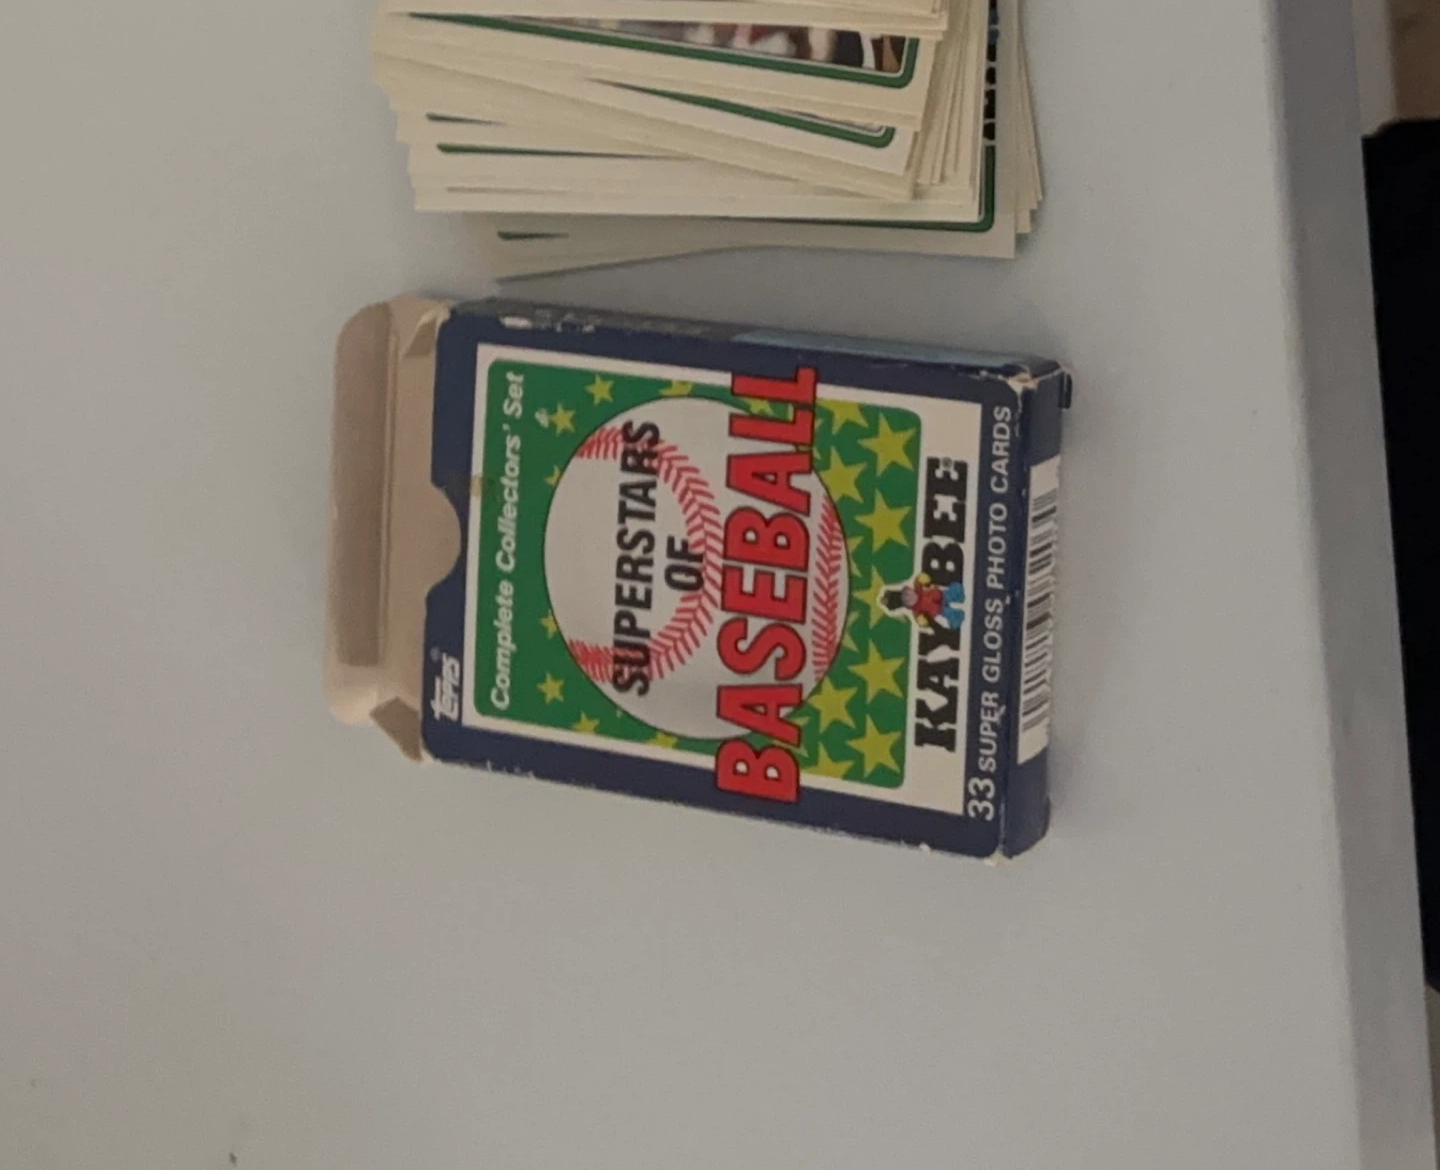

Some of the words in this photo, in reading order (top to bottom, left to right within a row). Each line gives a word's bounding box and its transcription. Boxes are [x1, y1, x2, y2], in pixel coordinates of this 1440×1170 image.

[504, 371, 525, 420] Set
[990, 404, 1013, 495] CARDS
[495, 424, 522, 574] Collectors'
[922, 456, 968, 586] BEE
[612, 419, 661, 697] SUPERSTARS
[664, 535, 705, 593] OF
[714, 364, 818, 805] BASEBALL
[986, 501, 1008, 591] PHOTO
[490, 580, 518, 711] Complete
[914, 620, 963, 753] KAY
[981, 599, 1004, 683] GLOSS
[978, 691, 1002, 773] SUPER
[967, 778, 996, 822] 33
